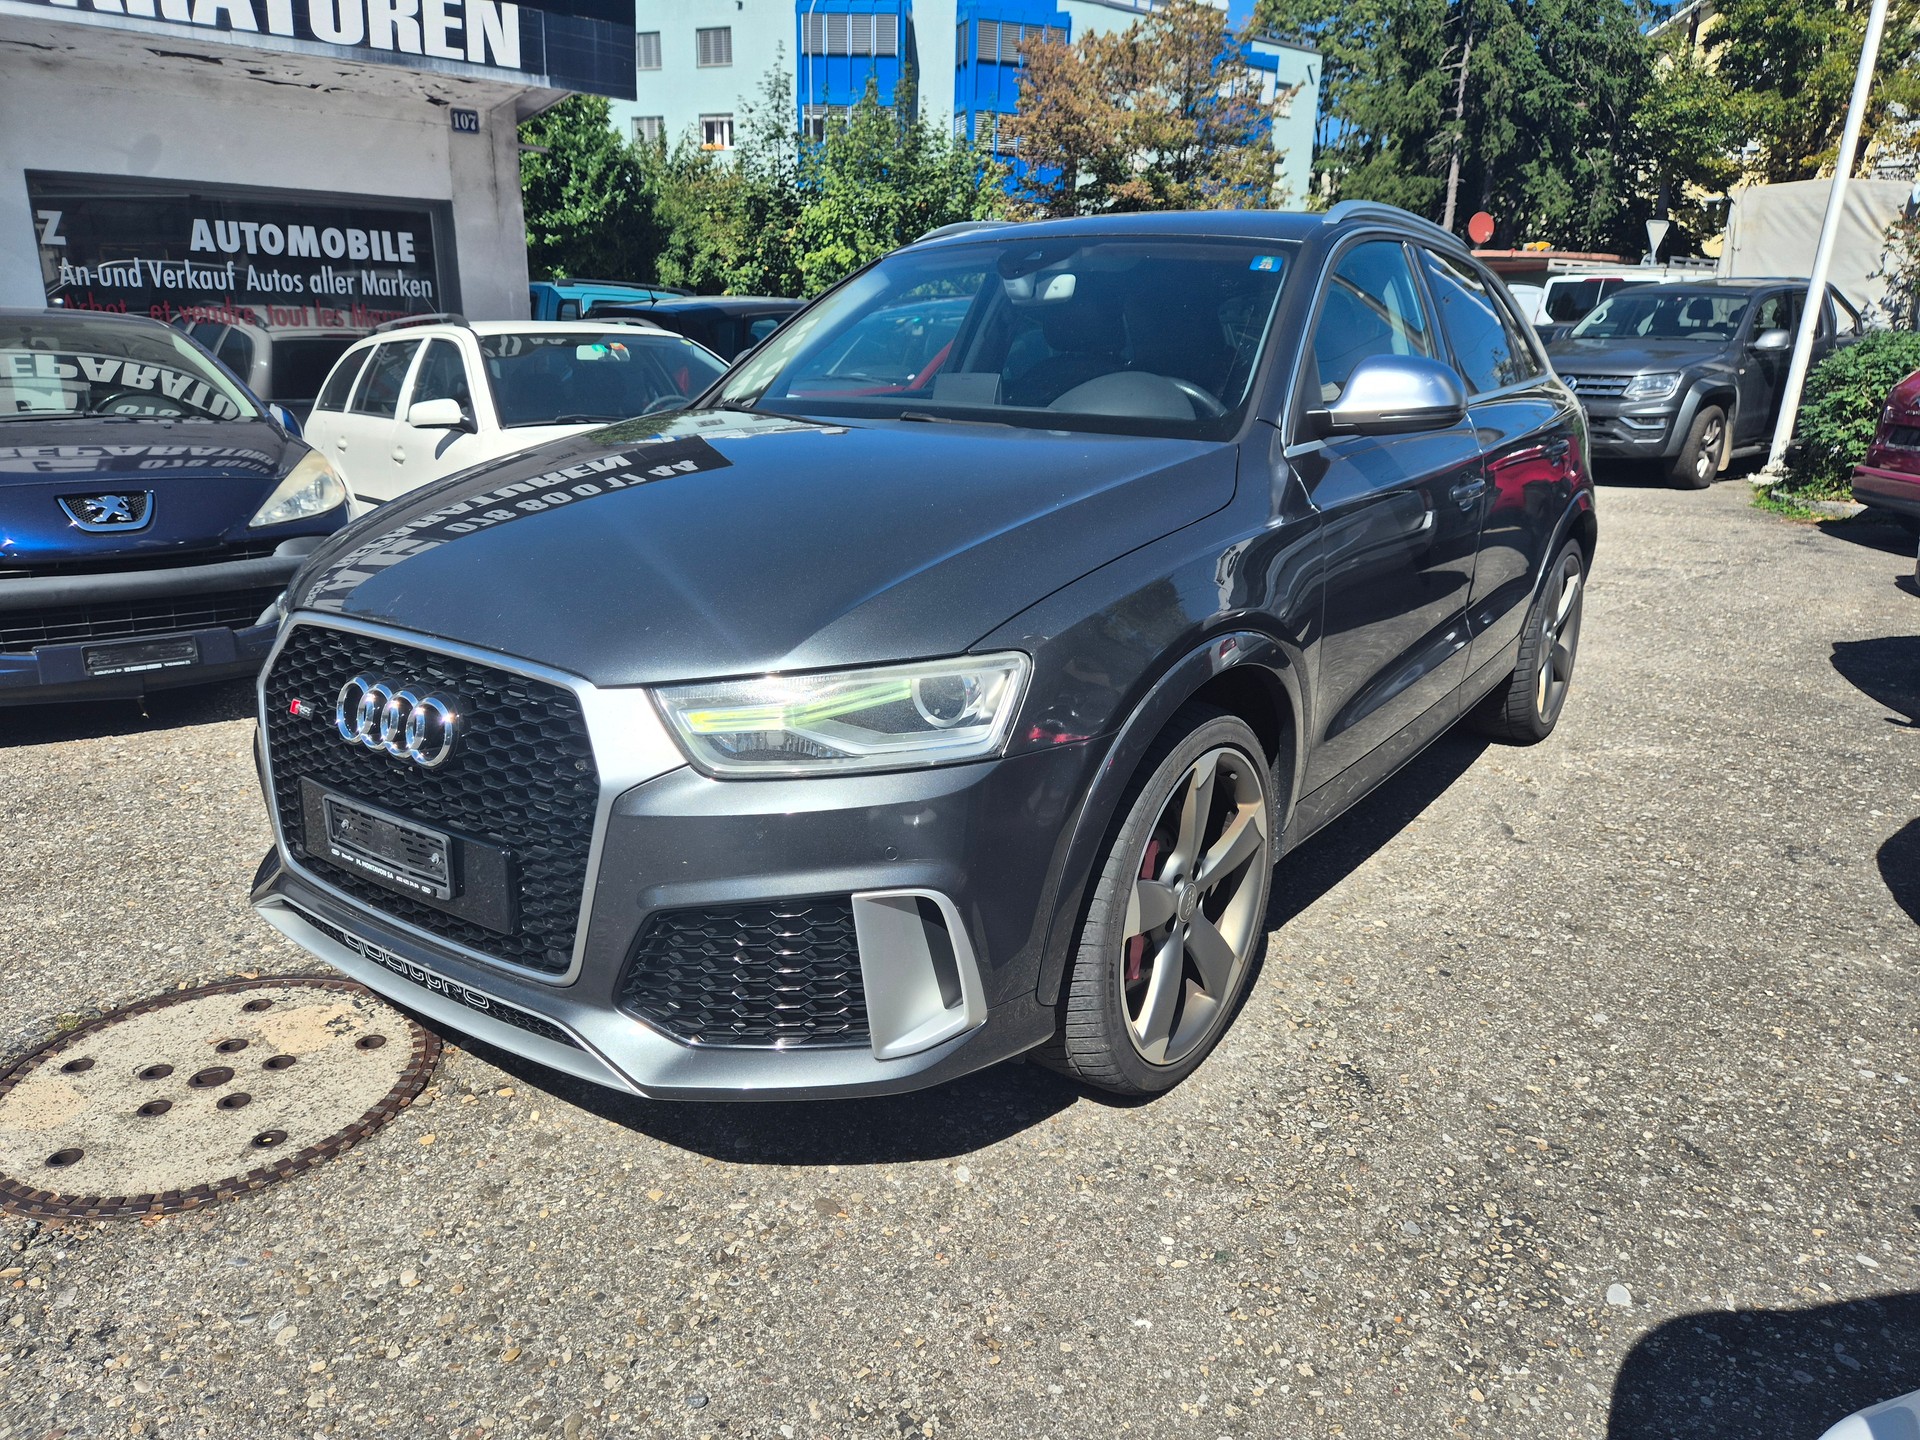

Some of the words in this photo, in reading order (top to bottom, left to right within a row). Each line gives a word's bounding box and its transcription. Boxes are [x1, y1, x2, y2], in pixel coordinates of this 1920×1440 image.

[453, 112, 476, 131] 107
[36, 209, 67, 246] Z
[190, 218, 416, 263] AUTOMOBILE
[147, 258, 236, 291] Verkauf
[246, 264, 304, 293] Autos
[309, 265, 355, 295] aller
[361, 269, 433, 298] Marken
[150, 299, 172, 323] et
[178, 294, 257, 326] vendre
[266, 303, 309, 327] tout
[314, 298, 345, 328] les
[343, 931, 490, 1010] quattro
